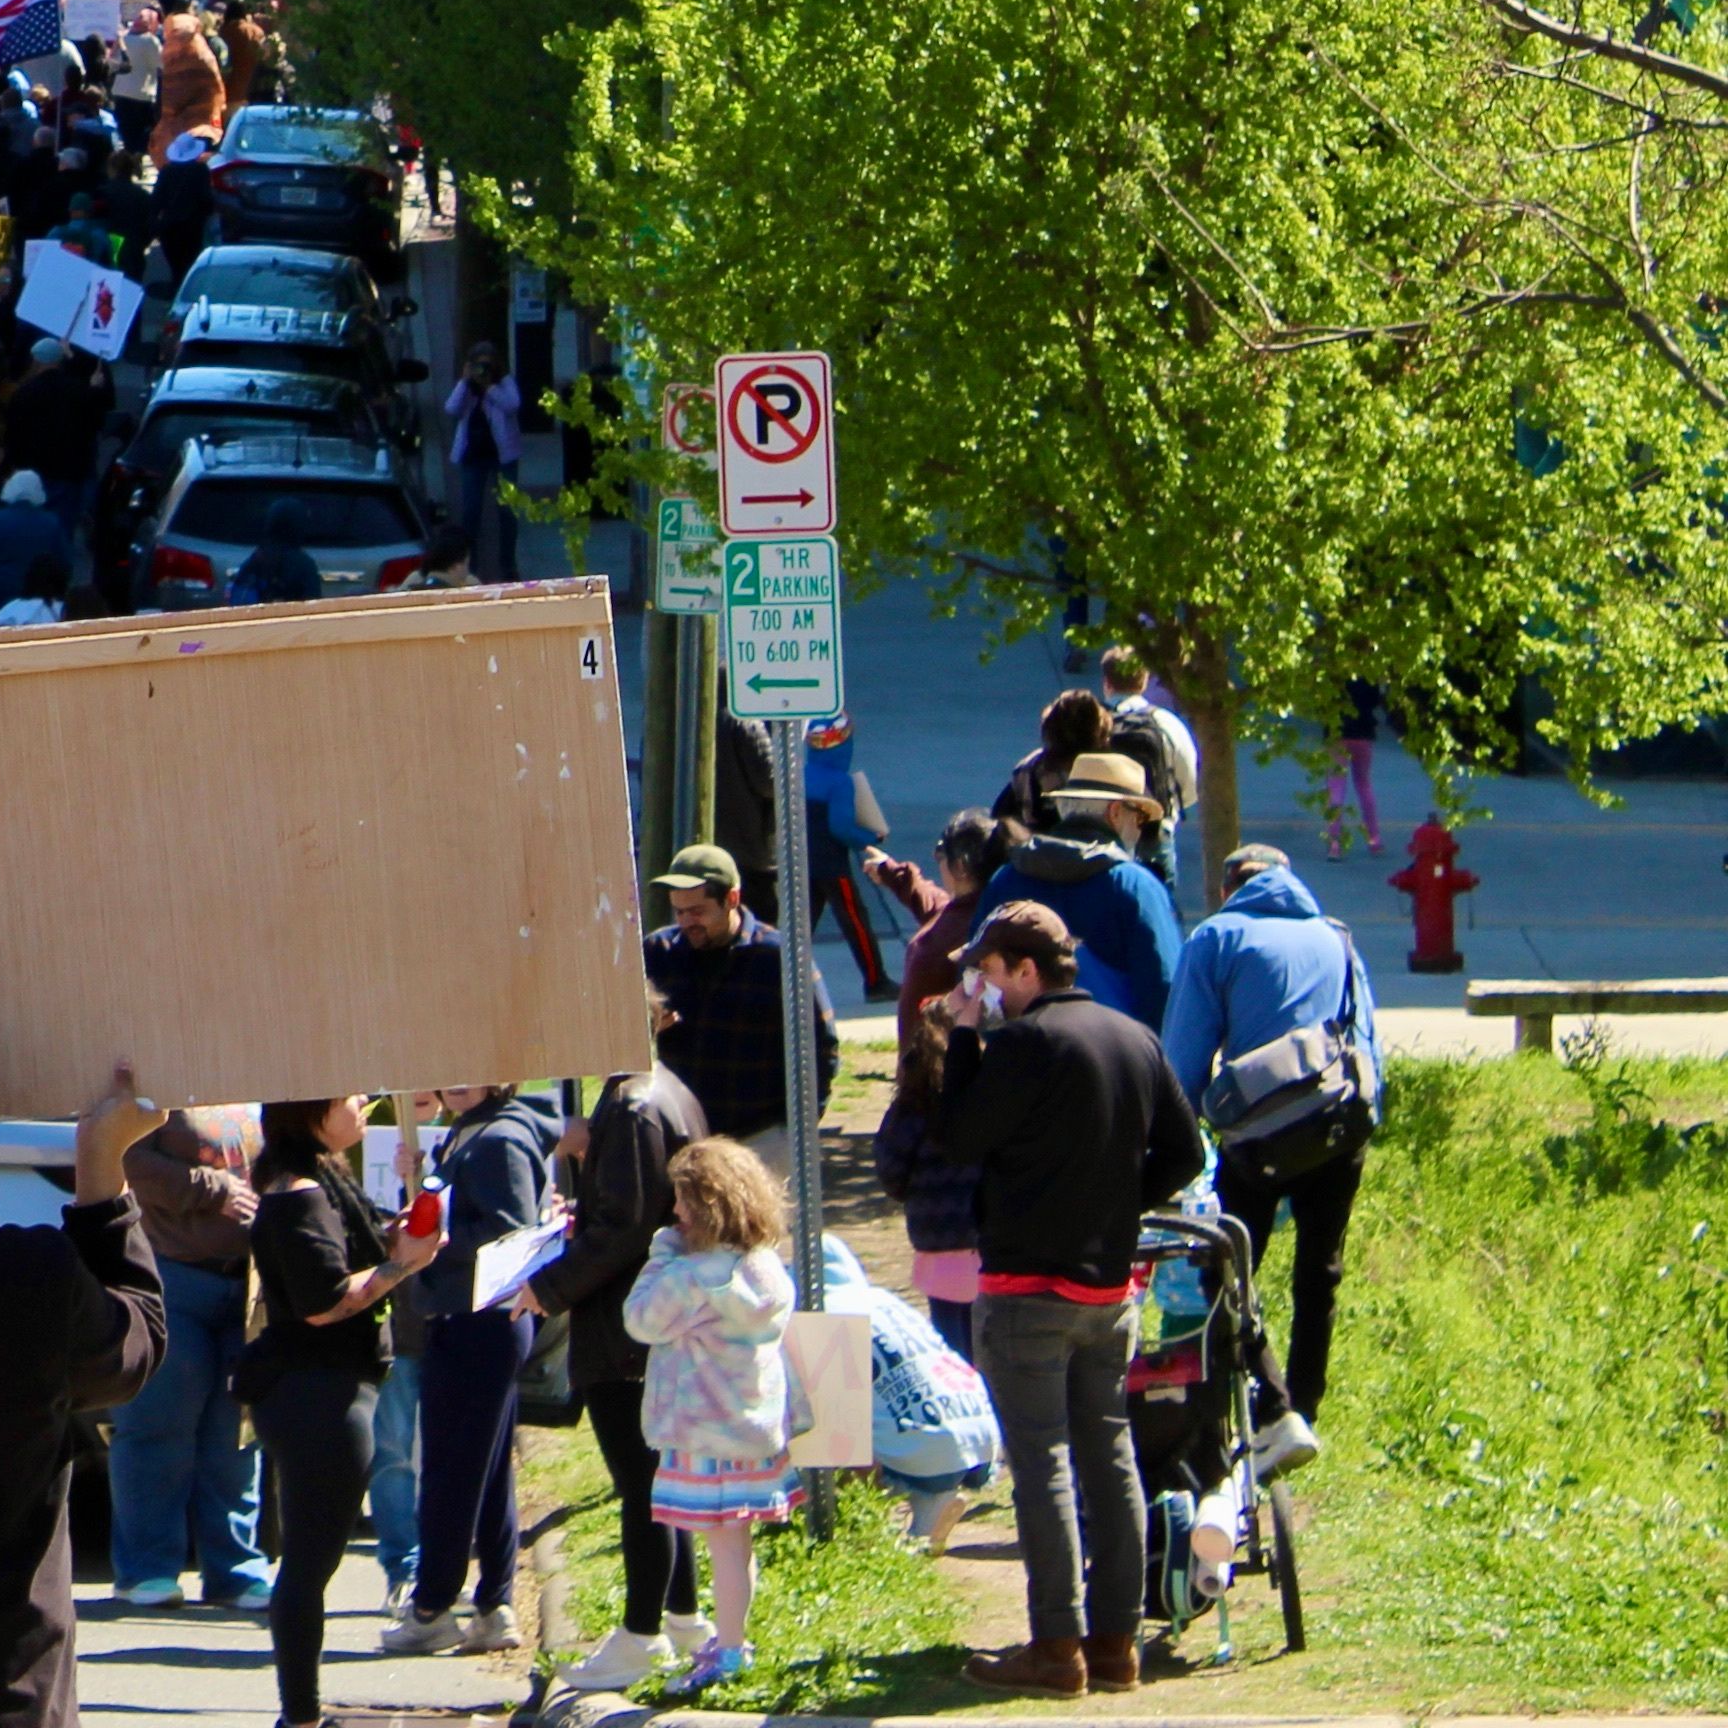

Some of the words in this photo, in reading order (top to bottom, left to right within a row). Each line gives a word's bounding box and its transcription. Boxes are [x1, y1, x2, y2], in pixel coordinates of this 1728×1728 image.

[731, 553, 756, 597] 2
[781, 547, 811, 569] HR
[762, 574, 830, 601] PARKING
[792, 609, 815, 630] AM
[582, 638, 599, 676] 4
[737, 640, 756, 663] TO
[765, 640, 800, 662] 6:00
[809, 639, 831, 662] PM
[887, 1382, 933, 1418] 1957
